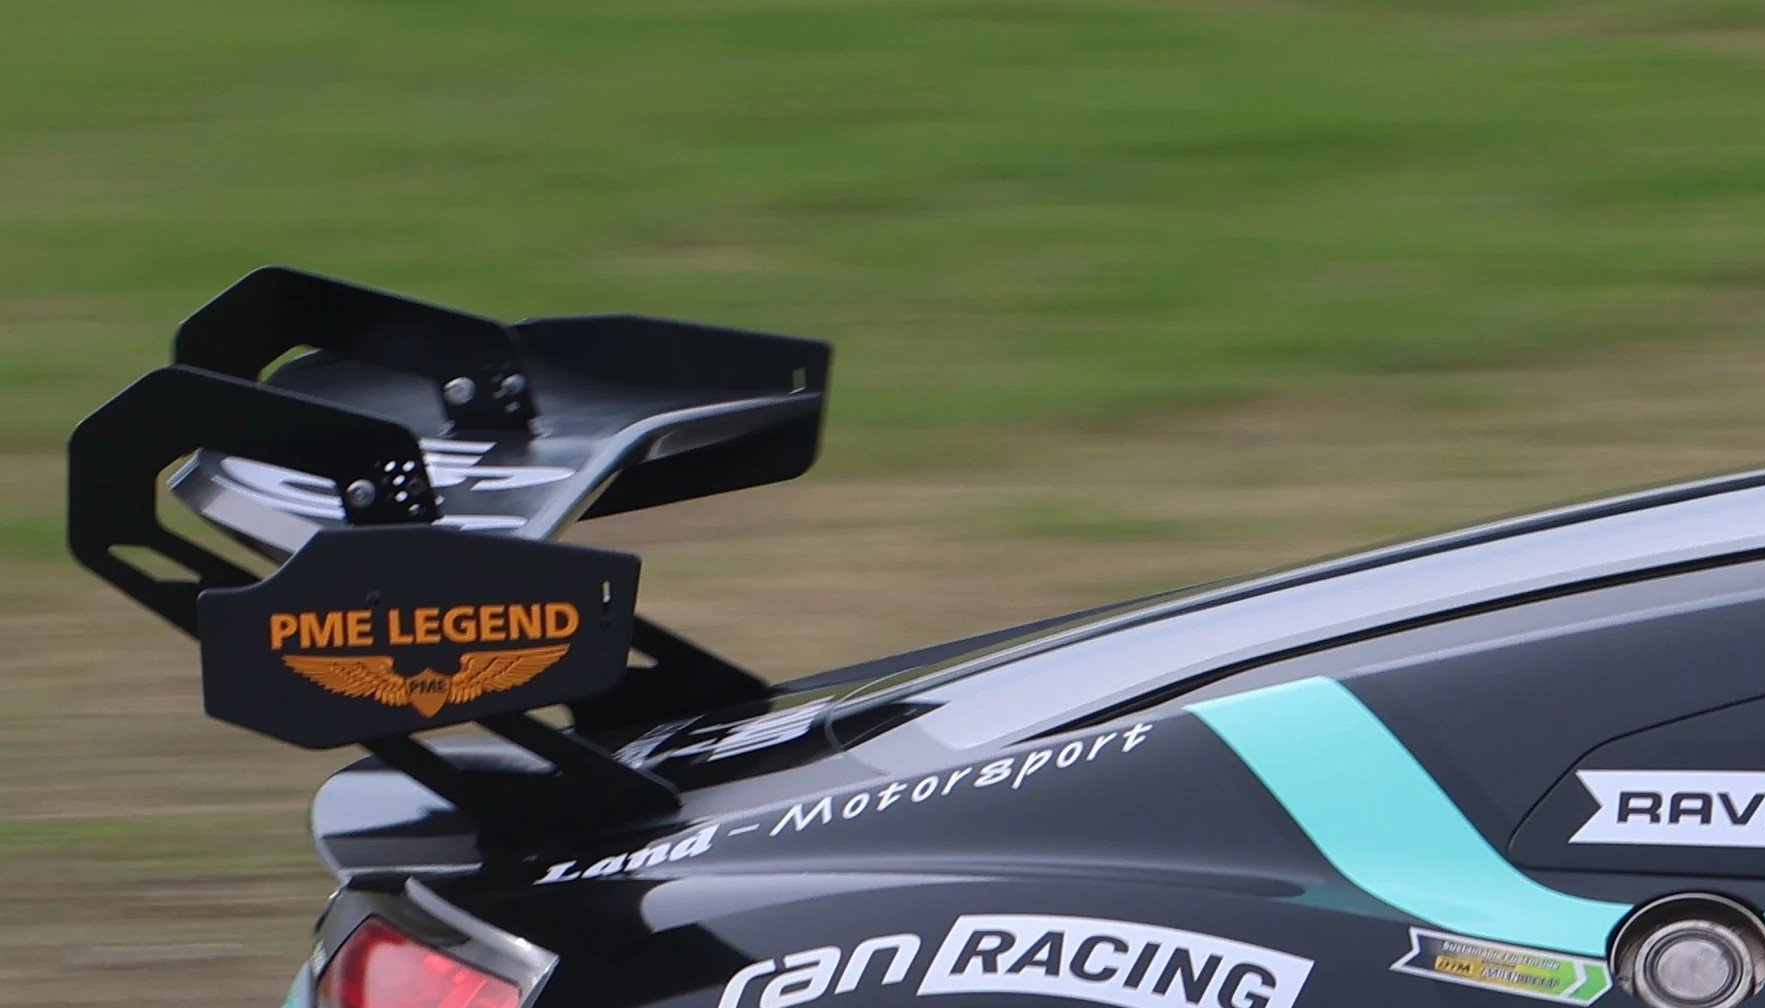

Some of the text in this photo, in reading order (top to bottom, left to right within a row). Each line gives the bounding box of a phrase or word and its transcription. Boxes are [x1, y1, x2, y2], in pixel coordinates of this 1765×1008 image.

[269, 601, 581, 651] PME LEGEND
[532, 823, 720, 885] Land
[769, 719, 1156, 837] Motorsport
